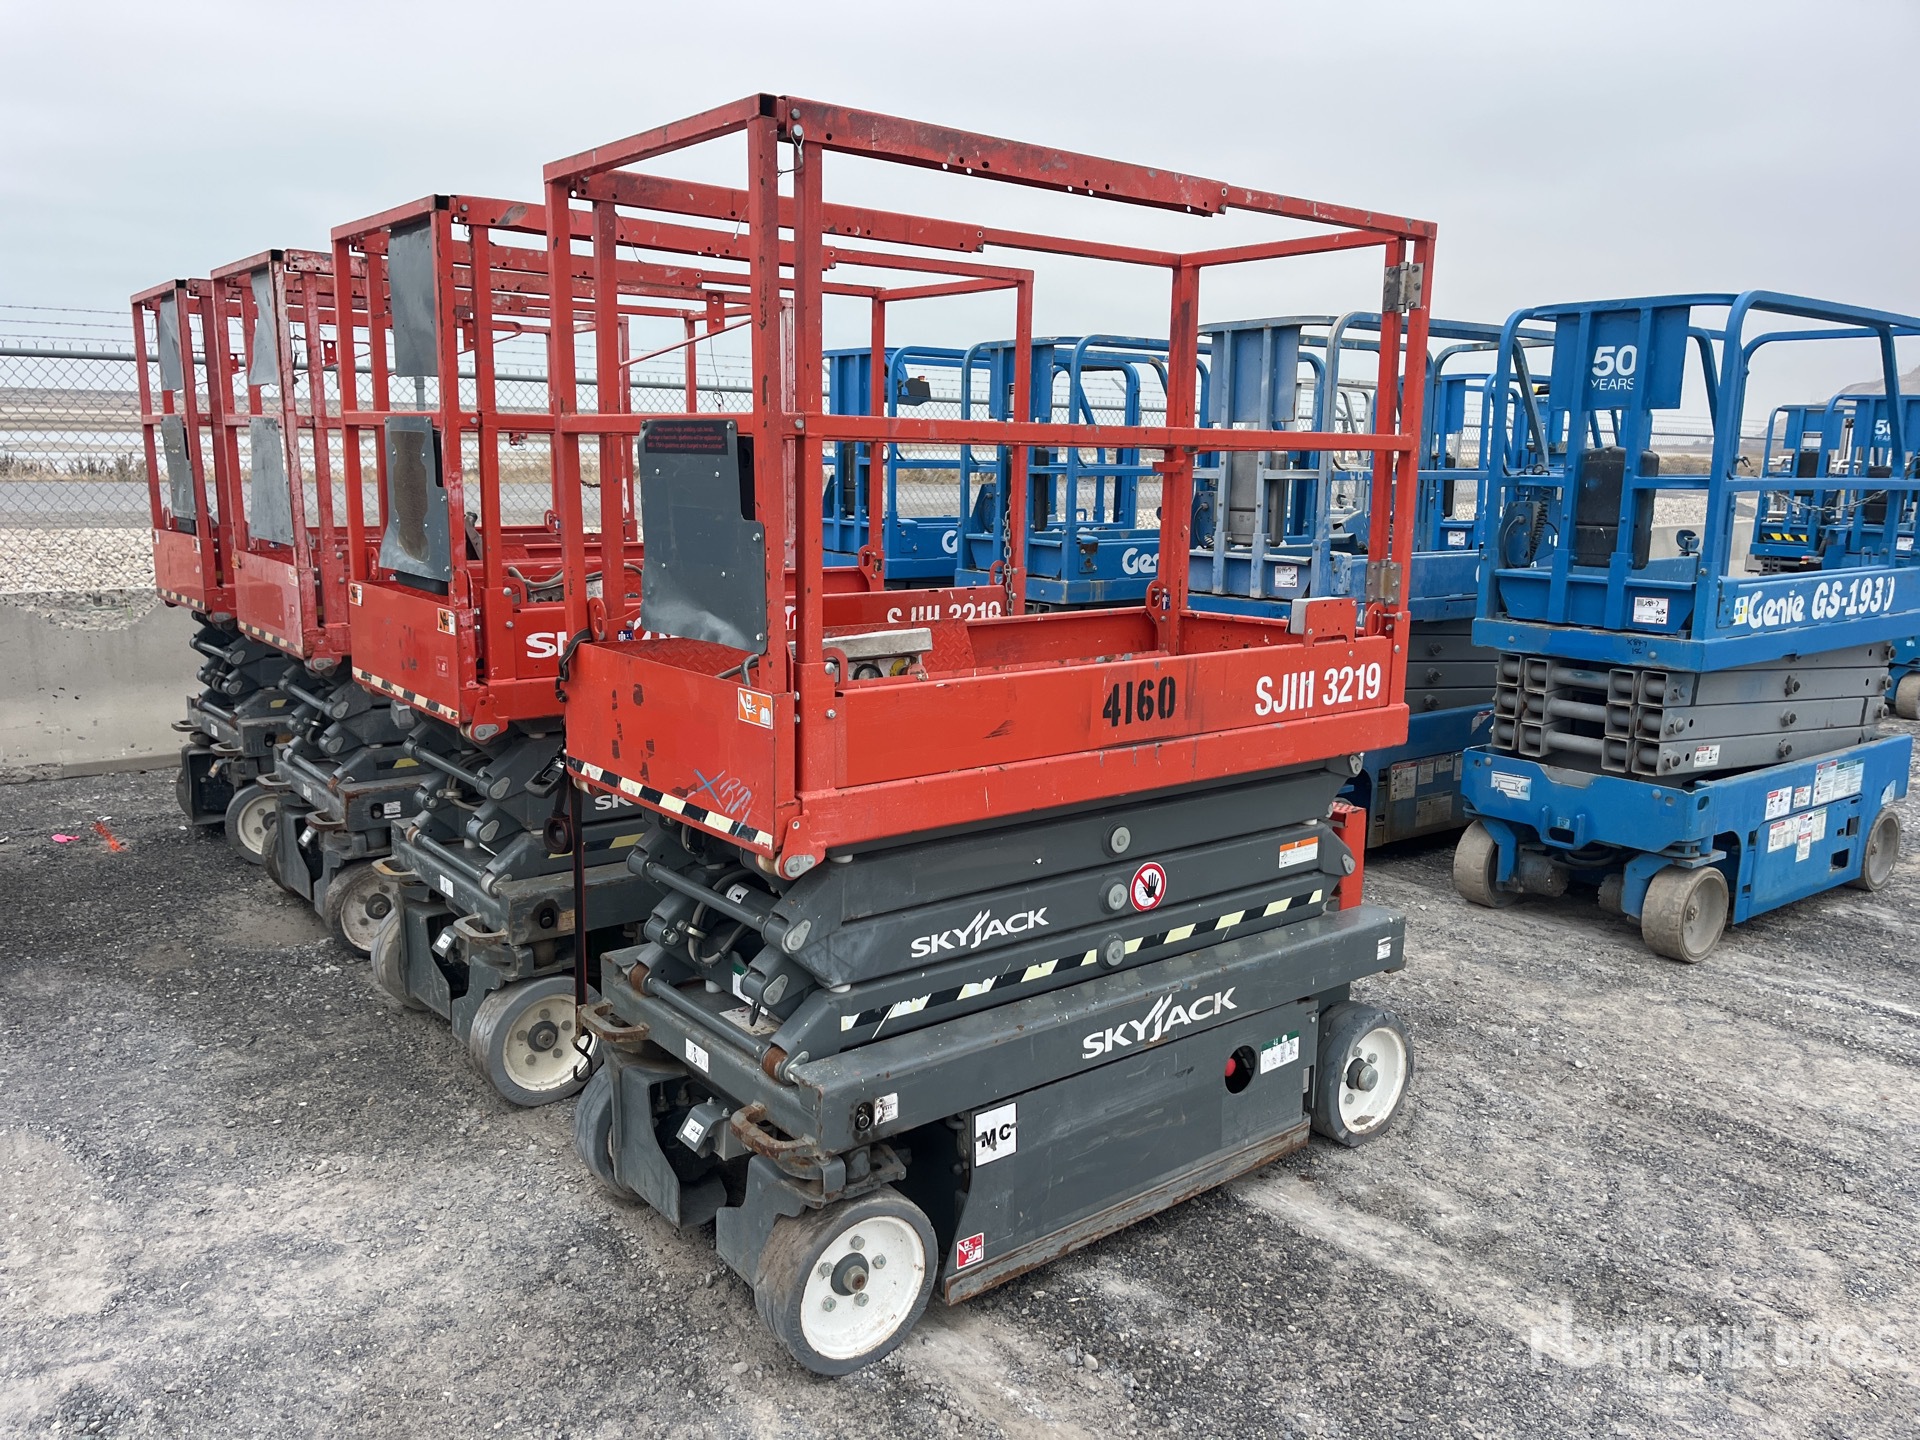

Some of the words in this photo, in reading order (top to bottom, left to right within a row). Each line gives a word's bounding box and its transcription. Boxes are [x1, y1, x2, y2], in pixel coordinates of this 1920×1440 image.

[1591, 344, 1638, 377] 50
[1590, 377, 1635, 391] YEARS
[1747, 590, 1805, 629] Genie
[1102, 675, 1176, 728] 4160
[1322, 662, 1382, 706] 3219
[910, 906, 1050, 959] SKYJACK
[1082, 986, 1238, 1059] SKYJACK
